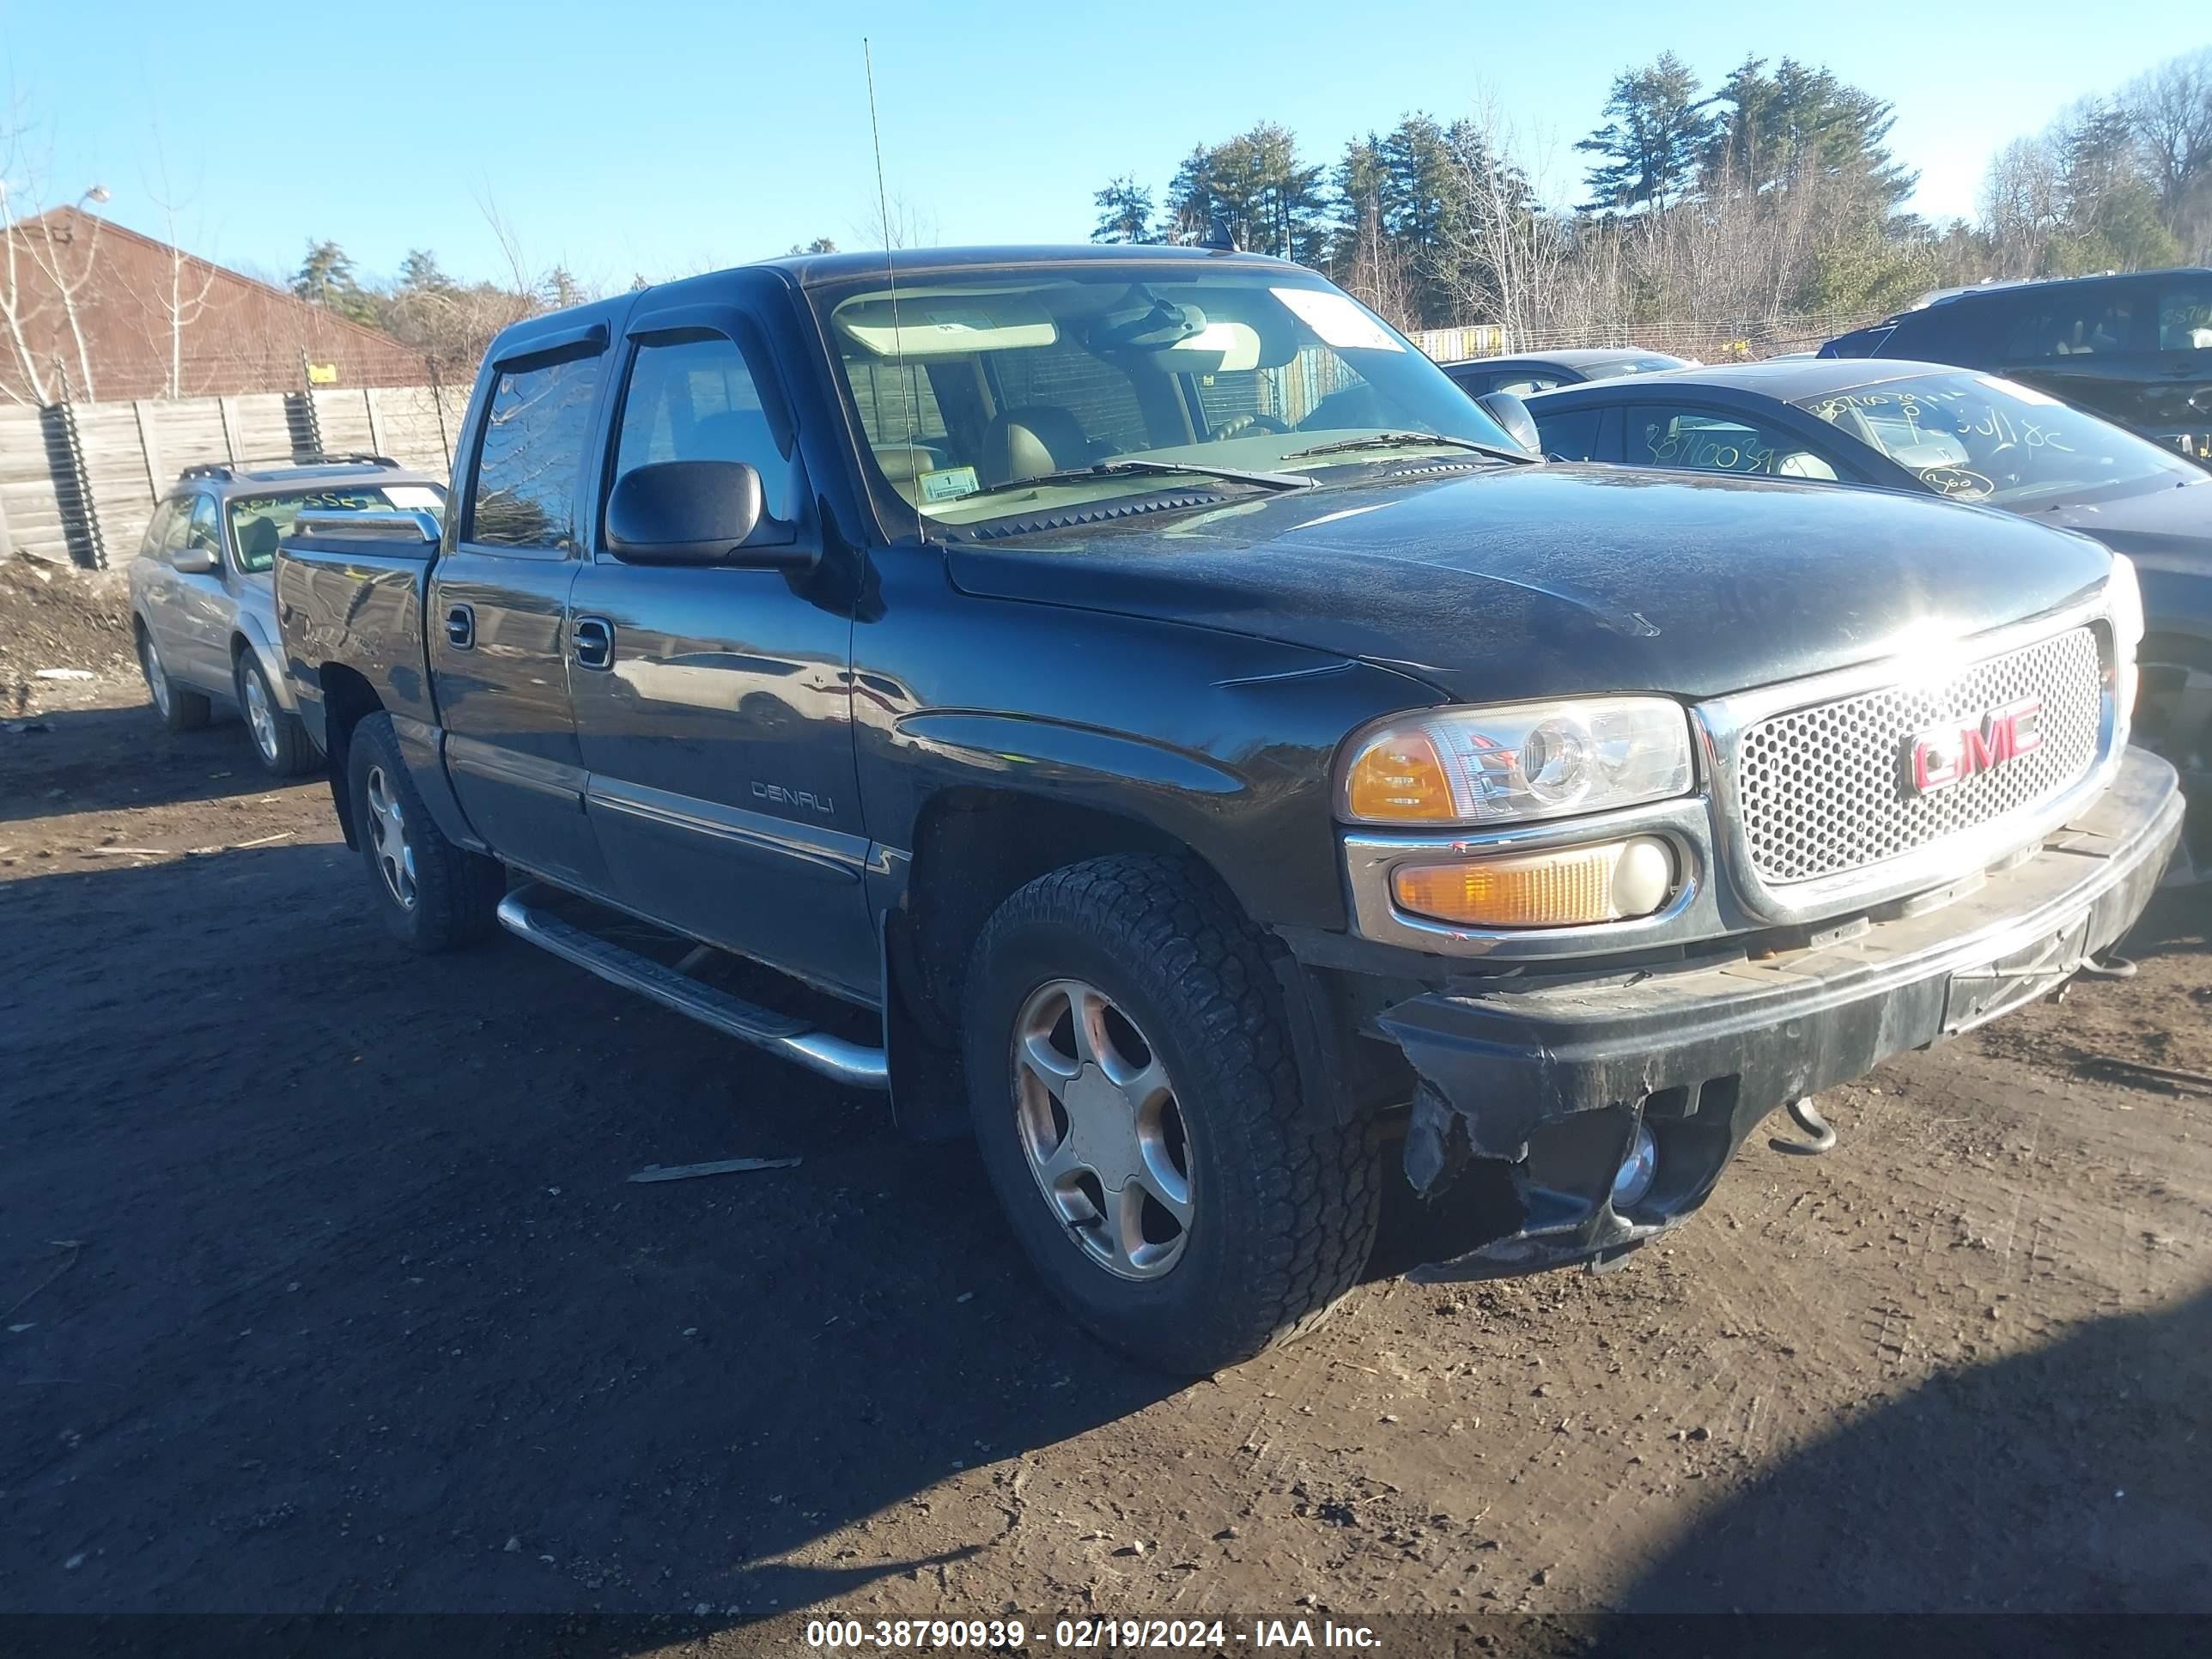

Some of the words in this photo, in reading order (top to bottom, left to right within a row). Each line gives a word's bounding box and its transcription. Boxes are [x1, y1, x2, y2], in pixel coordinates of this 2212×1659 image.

[1925, 473, 1972, 494] 360
[1911, 700, 2045, 792] GMC
[750, 781, 836, 815] DENALI
